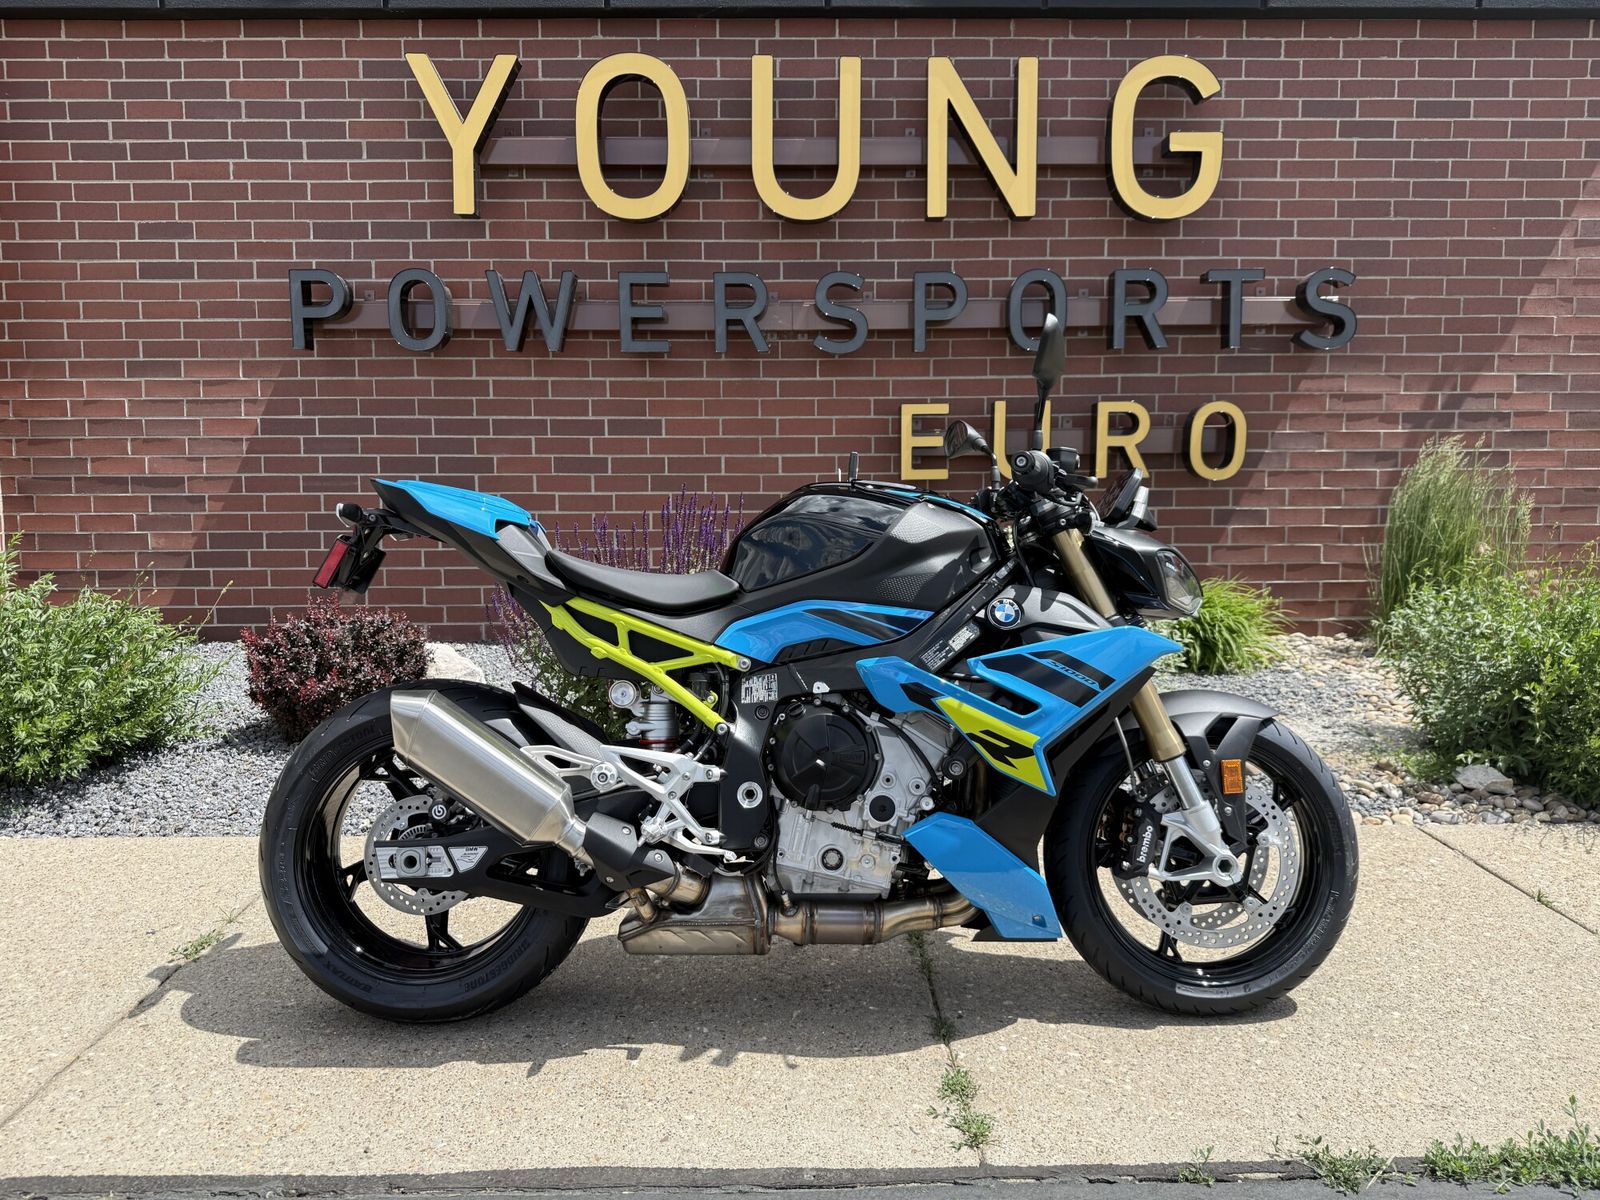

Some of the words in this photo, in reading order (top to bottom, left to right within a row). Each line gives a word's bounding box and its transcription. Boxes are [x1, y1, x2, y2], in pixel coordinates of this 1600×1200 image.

[405, 52, 1224, 220] YOUNG
[289, 267, 1357, 353] POWERSPORTS
[901, 401, 1247, 481] EURO
[1136, 825, 1153, 863] brembo
